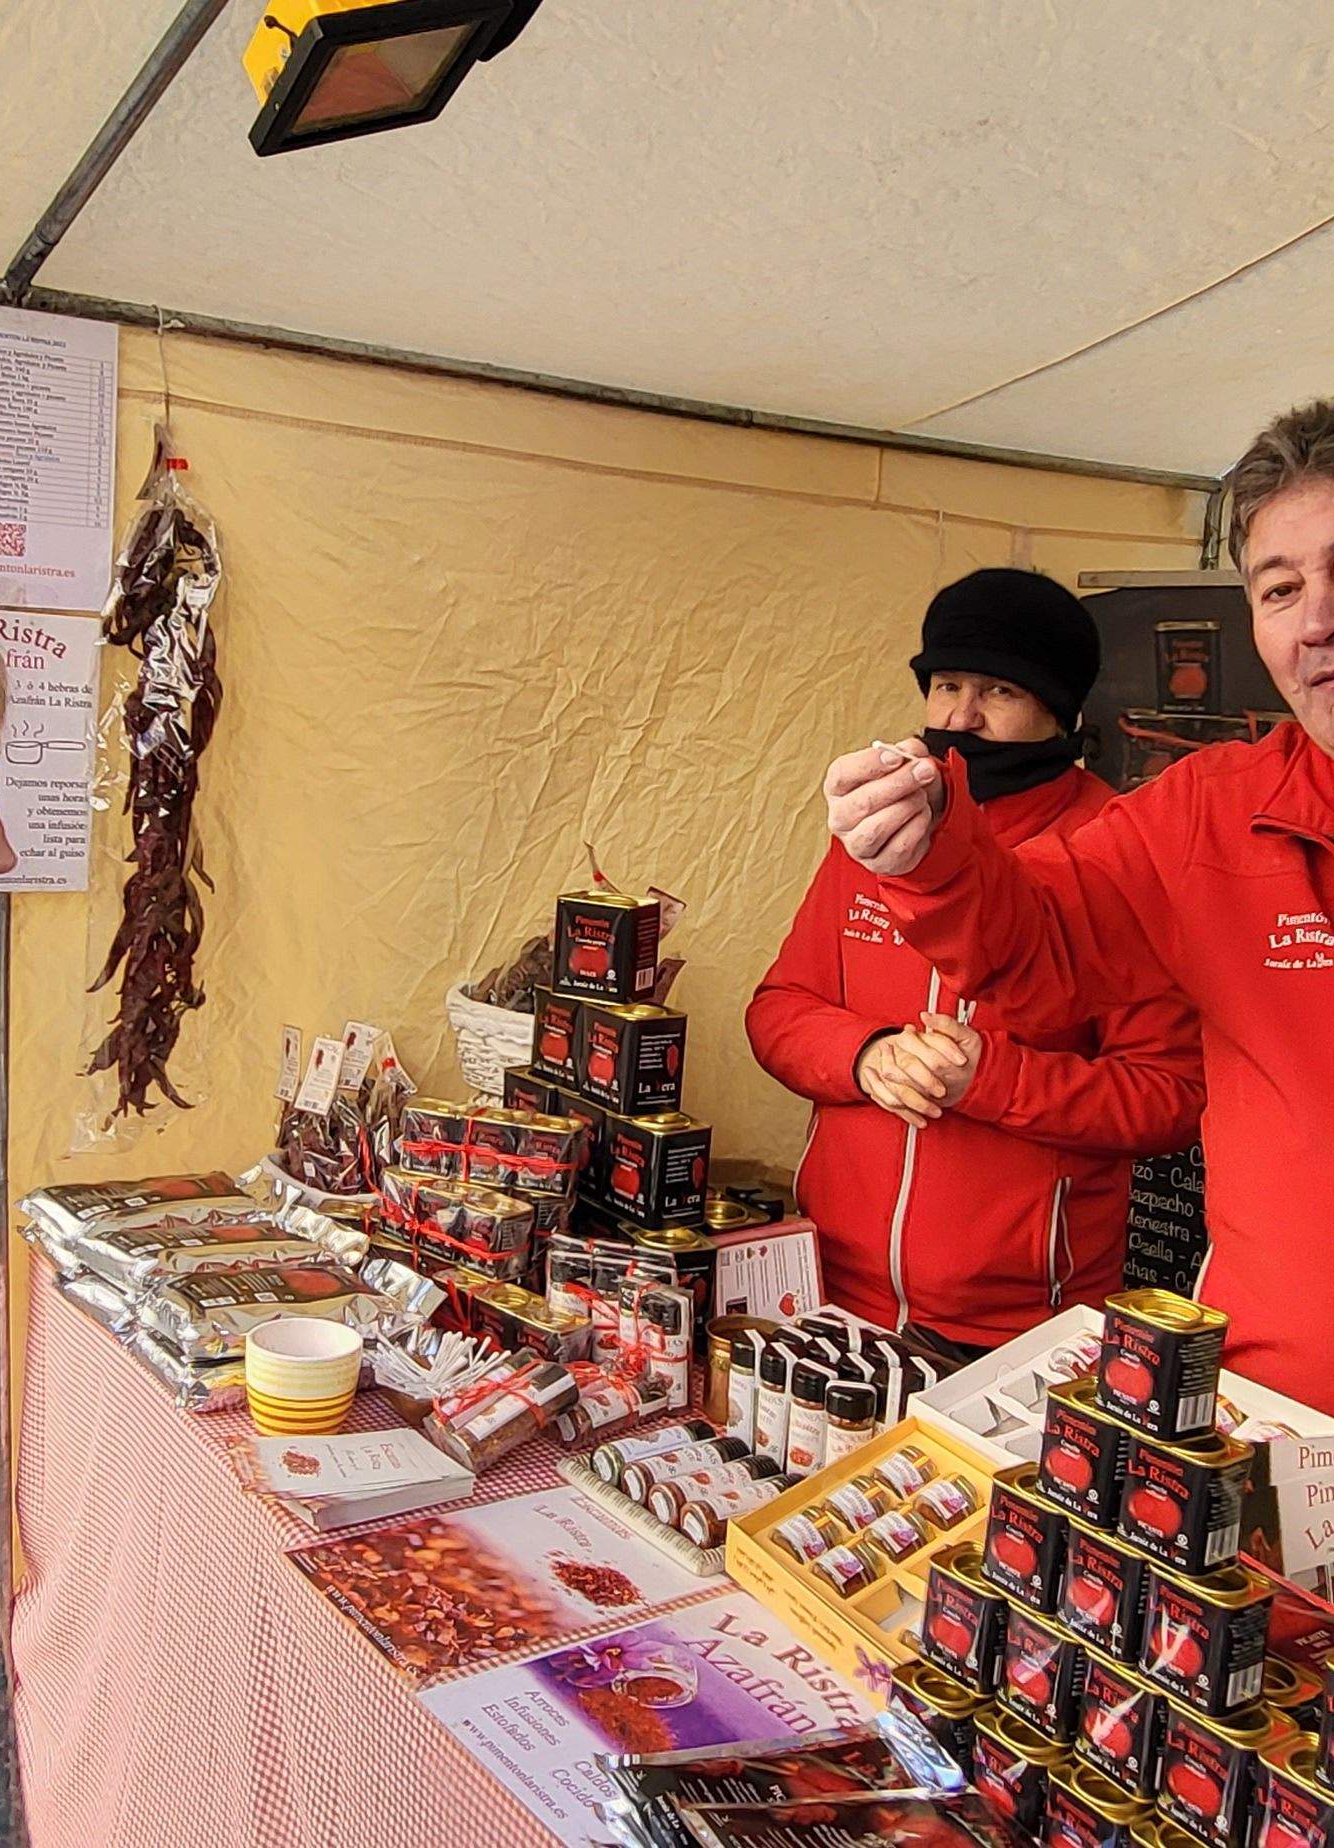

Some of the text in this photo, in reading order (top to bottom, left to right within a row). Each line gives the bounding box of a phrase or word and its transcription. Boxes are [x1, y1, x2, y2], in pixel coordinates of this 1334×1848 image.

[6, 648, 45, 670] frán
[38, 682, 45, 691] 4
[48, 682, 79, 693] hebras
[81, 684, 93, 694] de
[49, 696, 61, 706] La
[64, 697, 92, 708] Ristra
[6, 777, 48, 789] Dejamos
[38, 794, 60, 802] unas
[27, 807, 87, 817] y obtenemos
[43, 834, 86, 845] lista para
[19, 848, 85, 859] echar al guiso
[567, 925, 616, 944] La Ristra
[1269, 934, 1292, 949] La
[639, 1082, 651, 1094] La
[1170, 1167, 1204, 1194] Cala
[665, 1195, 677, 1207] La
[1104, 1328, 1160, 1367] La Ristra
[1132, 1414, 1141, 1424] La
[1046, 1418, 1100, 1459] La Ristra
[1127, 1459, 1191, 1501] La Ristra
[533, 1504, 557, 1519] La
[991, 1505, 1044, 1545] La Ristra
[1305, 1518, 1334, 1550] La
[1159, 1547, 1168, 1558] La
[1086, 1556, 1123, 1593] Ristra
[709, 1612, 770, 1648] La
[771, 1643, 865, 1731] Ristra
[682, 1639, 817, 1734] Azafrán
[525, 1690, 570, 1727] Arroces
[481, 1703, 536, 1751] Estofados
[503, 1696, 561, 1746] Infusiones
[462, 1719, 568, 1820] www.pimentonlaristra.es
[575, 1761, 617, 1798] Caldos
[551, 1769, 595, 1808] Cocido
